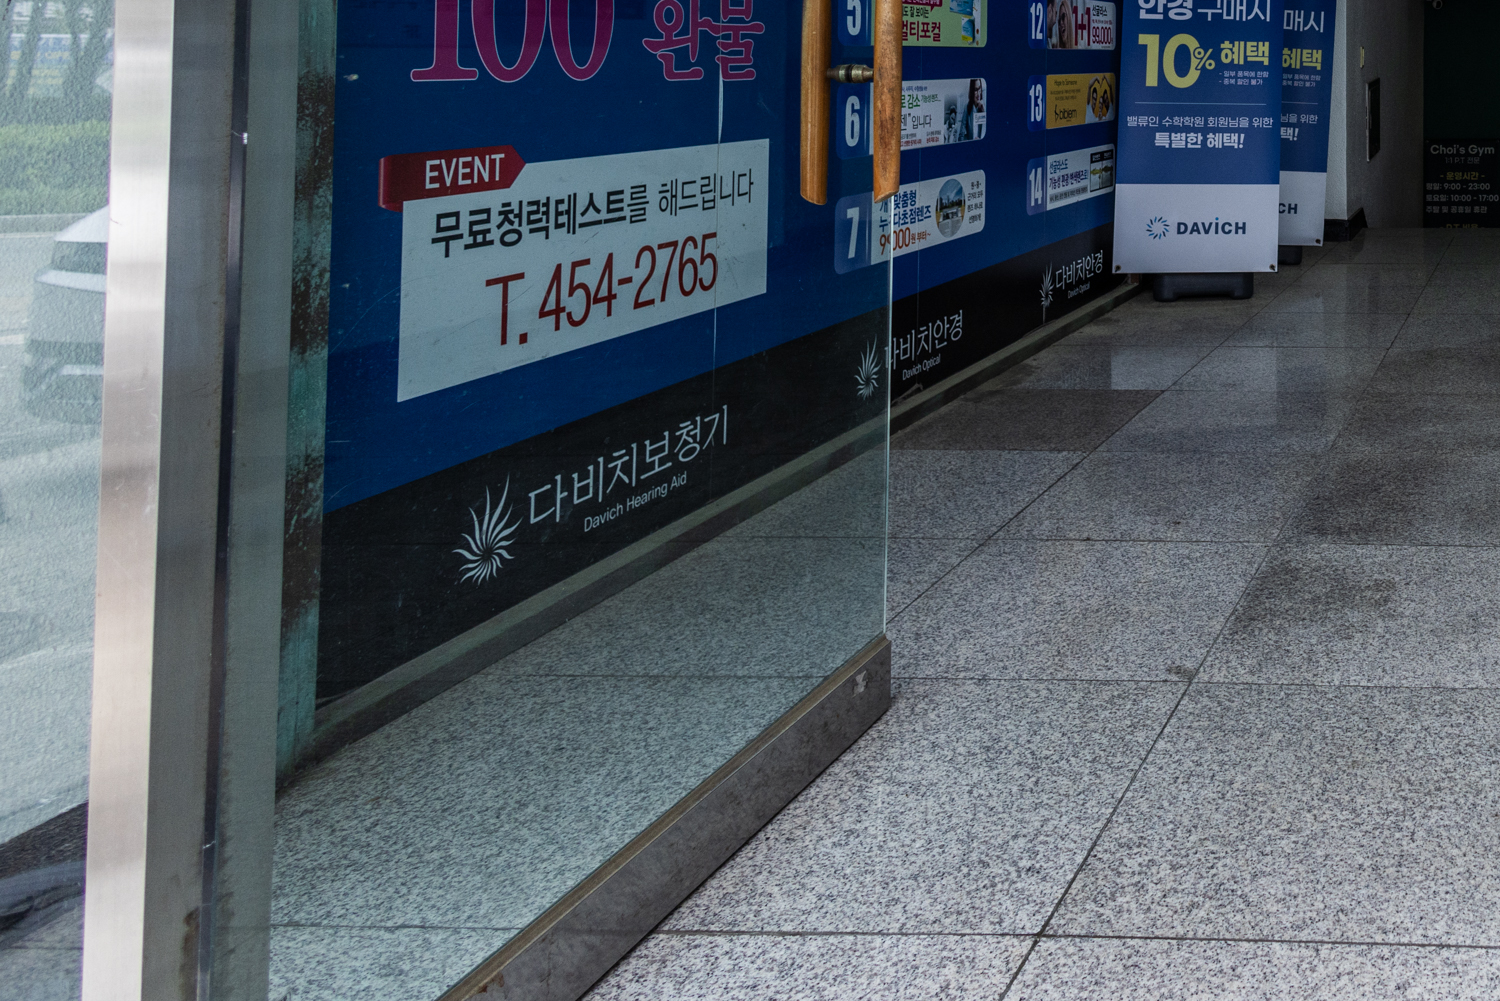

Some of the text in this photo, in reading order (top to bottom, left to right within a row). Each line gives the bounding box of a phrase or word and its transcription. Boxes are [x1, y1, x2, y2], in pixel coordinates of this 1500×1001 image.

[1030, 2, 1043, 39] 12
[1072, 5, 1091, 46] 1+1
[1092, 4, 1108, 17] 선글라스
[1283, 9, 1325, 33] 매시
[1138, 33, 1216, 89] 10%
[1220, 40, 1270, 66] 혜택
[1281, 47, 1322, 70] 혜택
[845, 95, 860, 147] 6
[1029, 84, 1042, 122] 13
[1127, 115, 1273, 128] 밸류인 수학학원 회원님을 위한
[1300, 114, 1318, 124] 위한
[1154, 132, 1245, 150] 특별한 혜택!
[1430, 144, 1495, 157] Choi's Gym
[424, 154, 505, 190] EVENT
[1029, 167, 1042, 206] 14
[1446, 171, 1479, 181] 운영시간
[430, 167, 755, 259] 무료청력테스트를 해드립니다
[847, 207, 859, 259] 7
[1055, 249, 1104, 290] 다비치안경
[884, 309, 963, 370] 다비치안경
[902, 354, 941, 381] Davich Optical
[528, 404, 728, 525] 다비치보청기
[583, 470, 687, 532] Davich Hearing Aid
